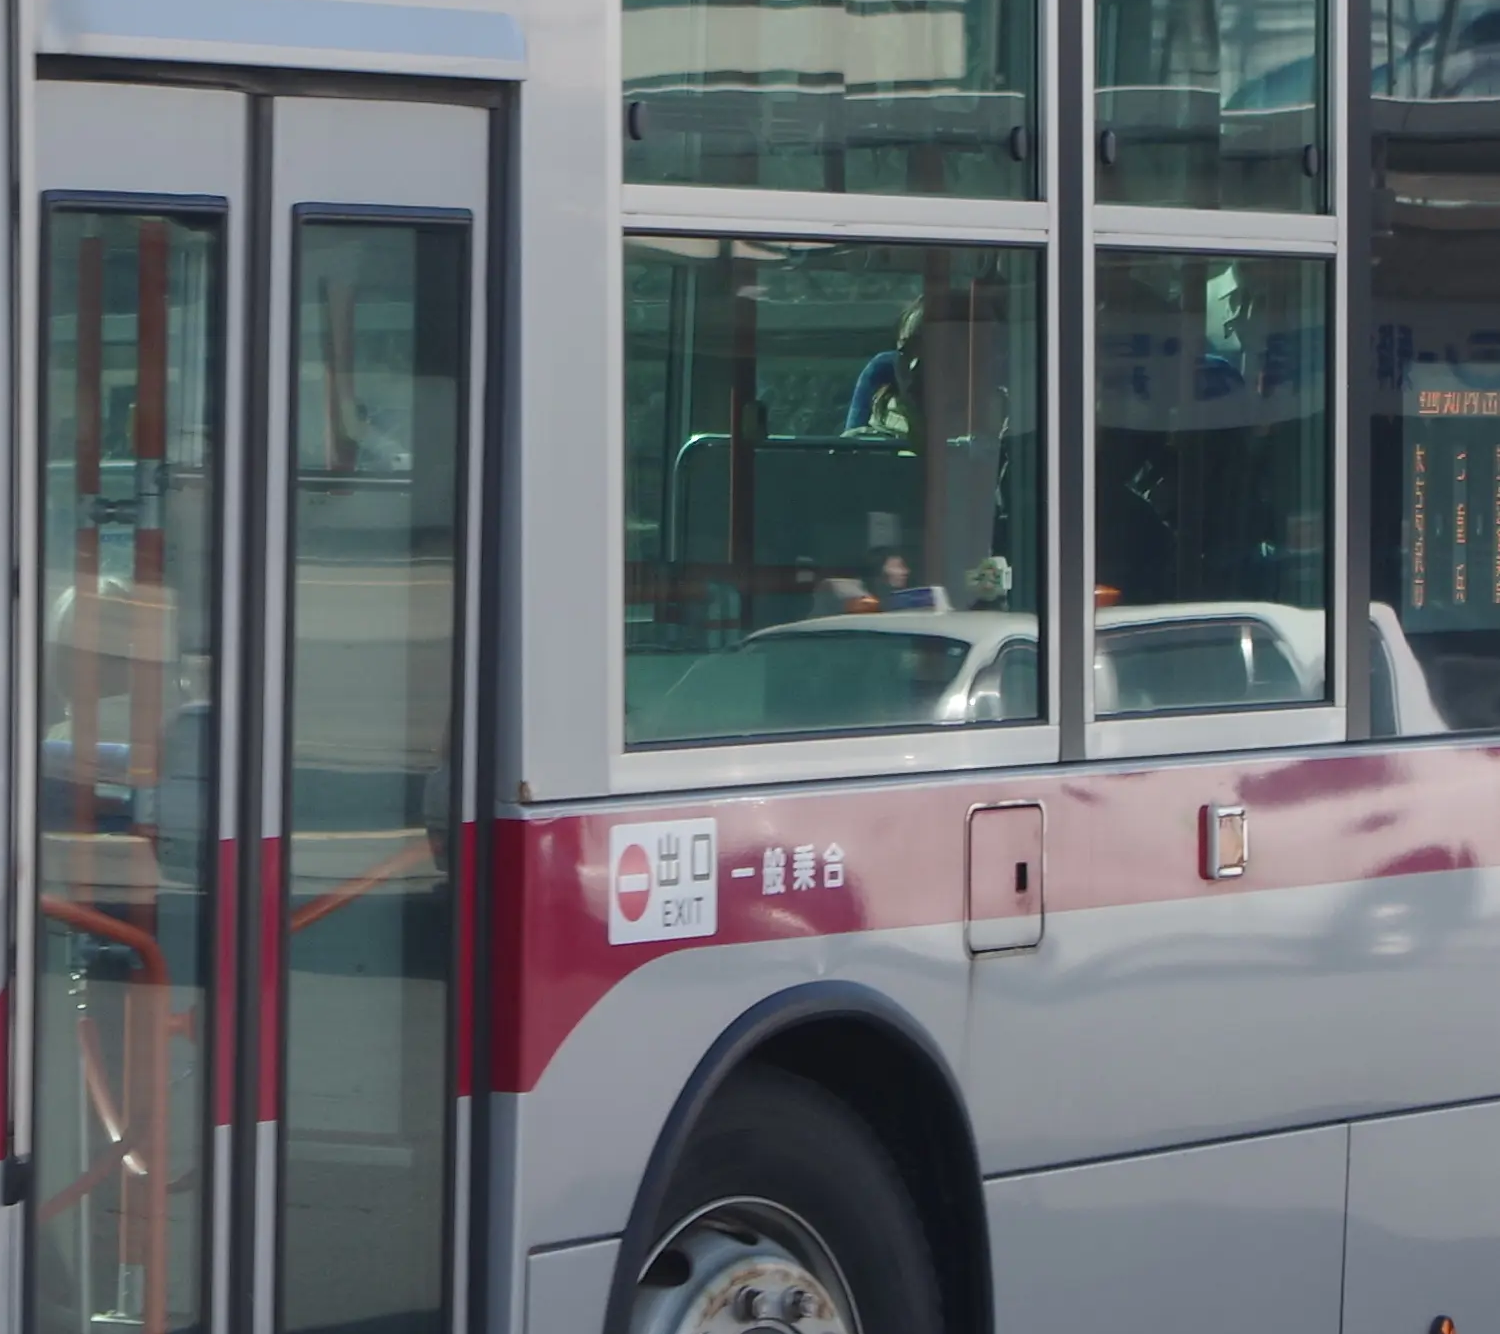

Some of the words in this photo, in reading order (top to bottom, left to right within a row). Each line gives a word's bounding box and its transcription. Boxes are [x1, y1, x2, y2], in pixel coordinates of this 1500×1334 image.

[657, 833, 712, 887] 出口
[730, 841, 845, 895] 一般乗合
[662, 896, 705, 928] EXIT
